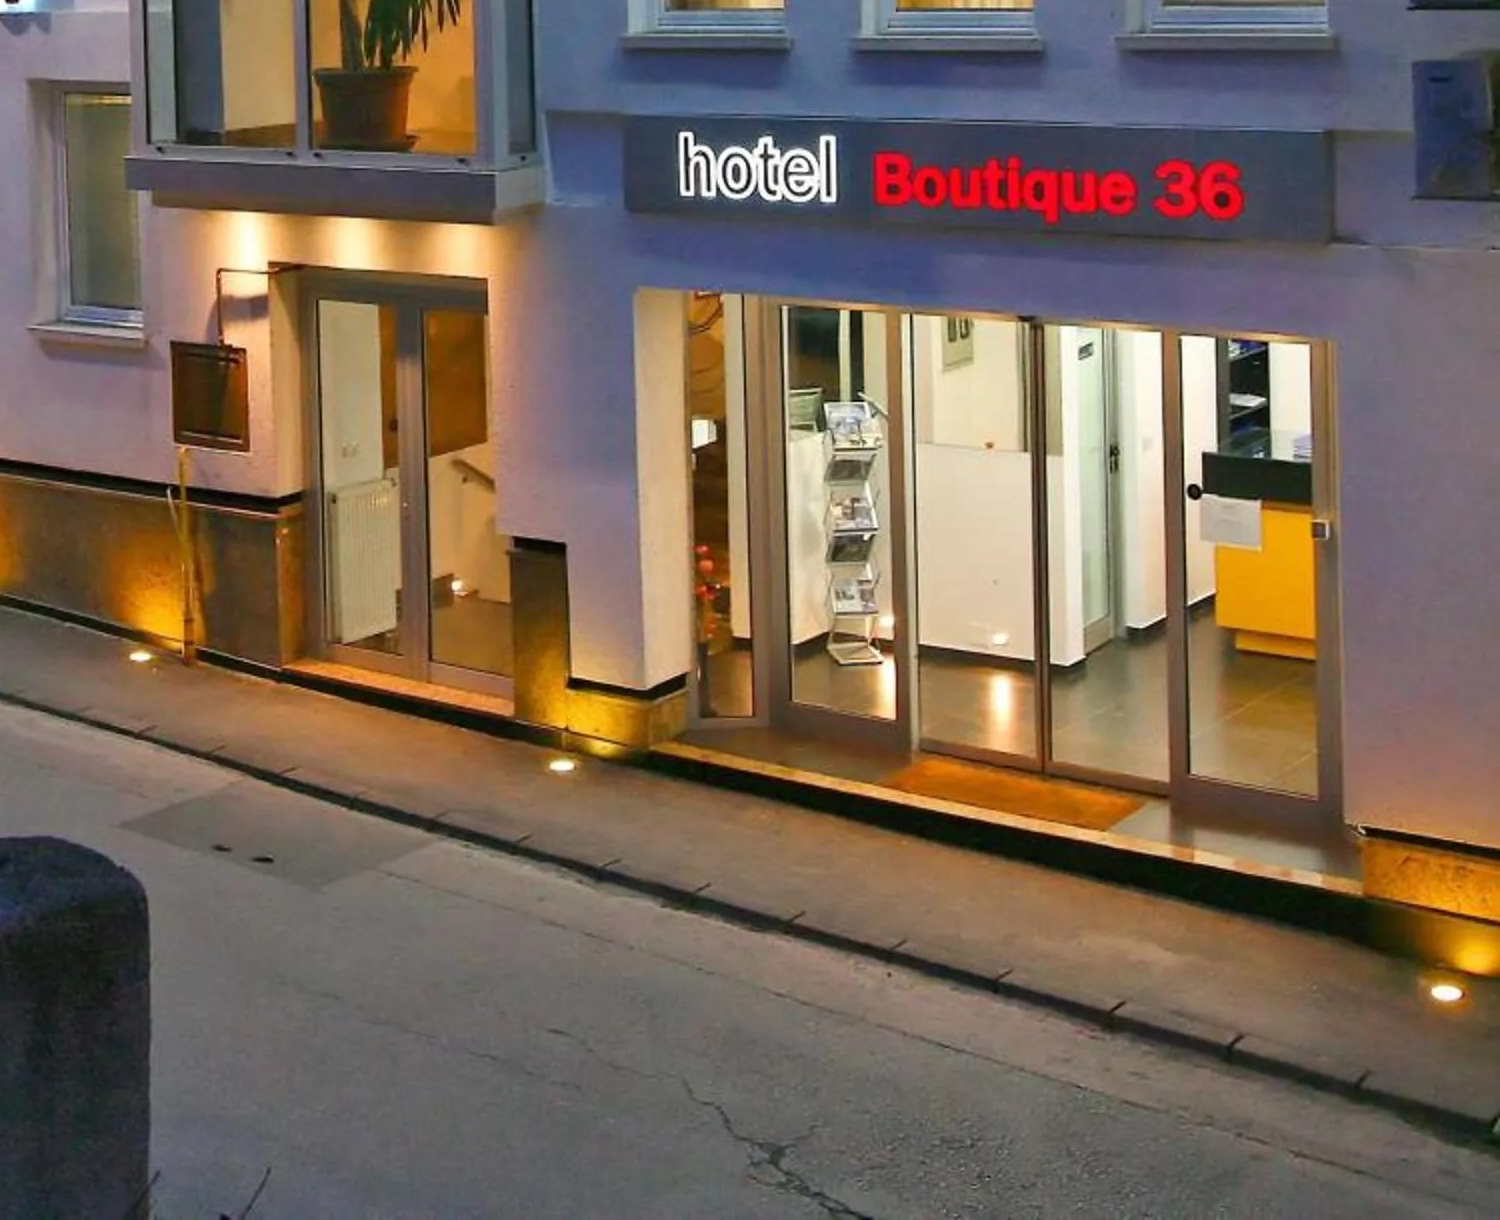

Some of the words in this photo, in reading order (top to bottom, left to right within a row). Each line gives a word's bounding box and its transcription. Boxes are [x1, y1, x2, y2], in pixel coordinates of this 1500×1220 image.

[677, 131, 837, 204] hotel
[873, 151, 1138, 224] Boutique
[1154, 160, 1244, 221] 36
